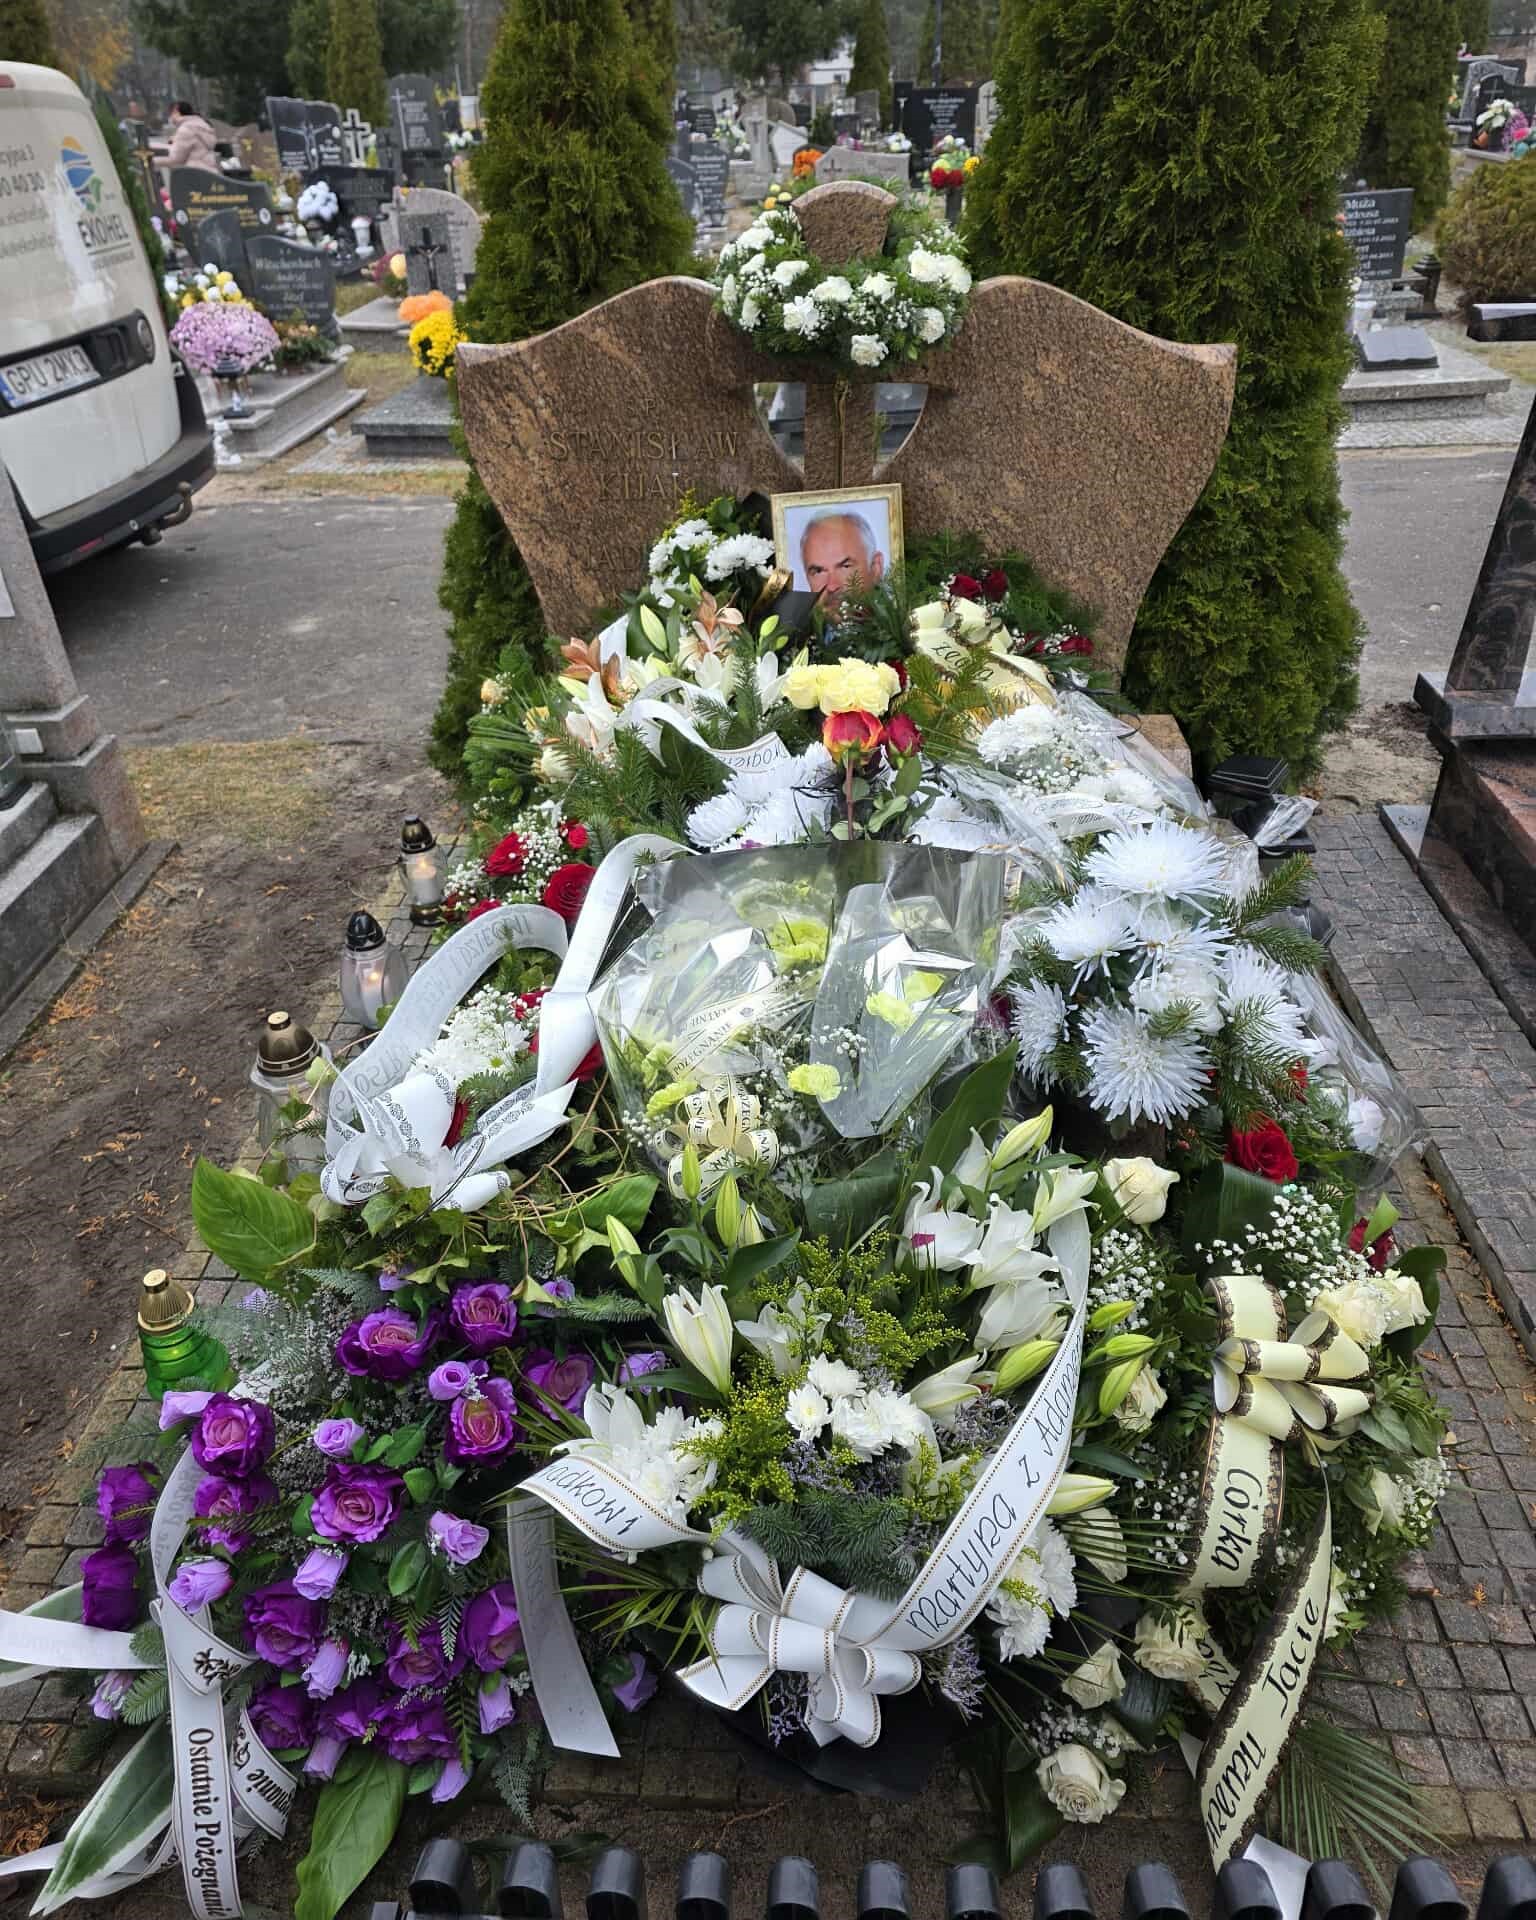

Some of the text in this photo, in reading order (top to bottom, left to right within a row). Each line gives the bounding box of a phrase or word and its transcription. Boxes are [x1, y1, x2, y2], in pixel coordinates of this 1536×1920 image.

[78, 213, 129, 248] EKOHEL
[550, 431, 738, 460] STANISŁAW
[1018, 1454, 1042, 1489] z
[1210, 1467, 1264, 1572] Córka
[187, 1727, 234, 1918] Ostatnie Pożegnanie
